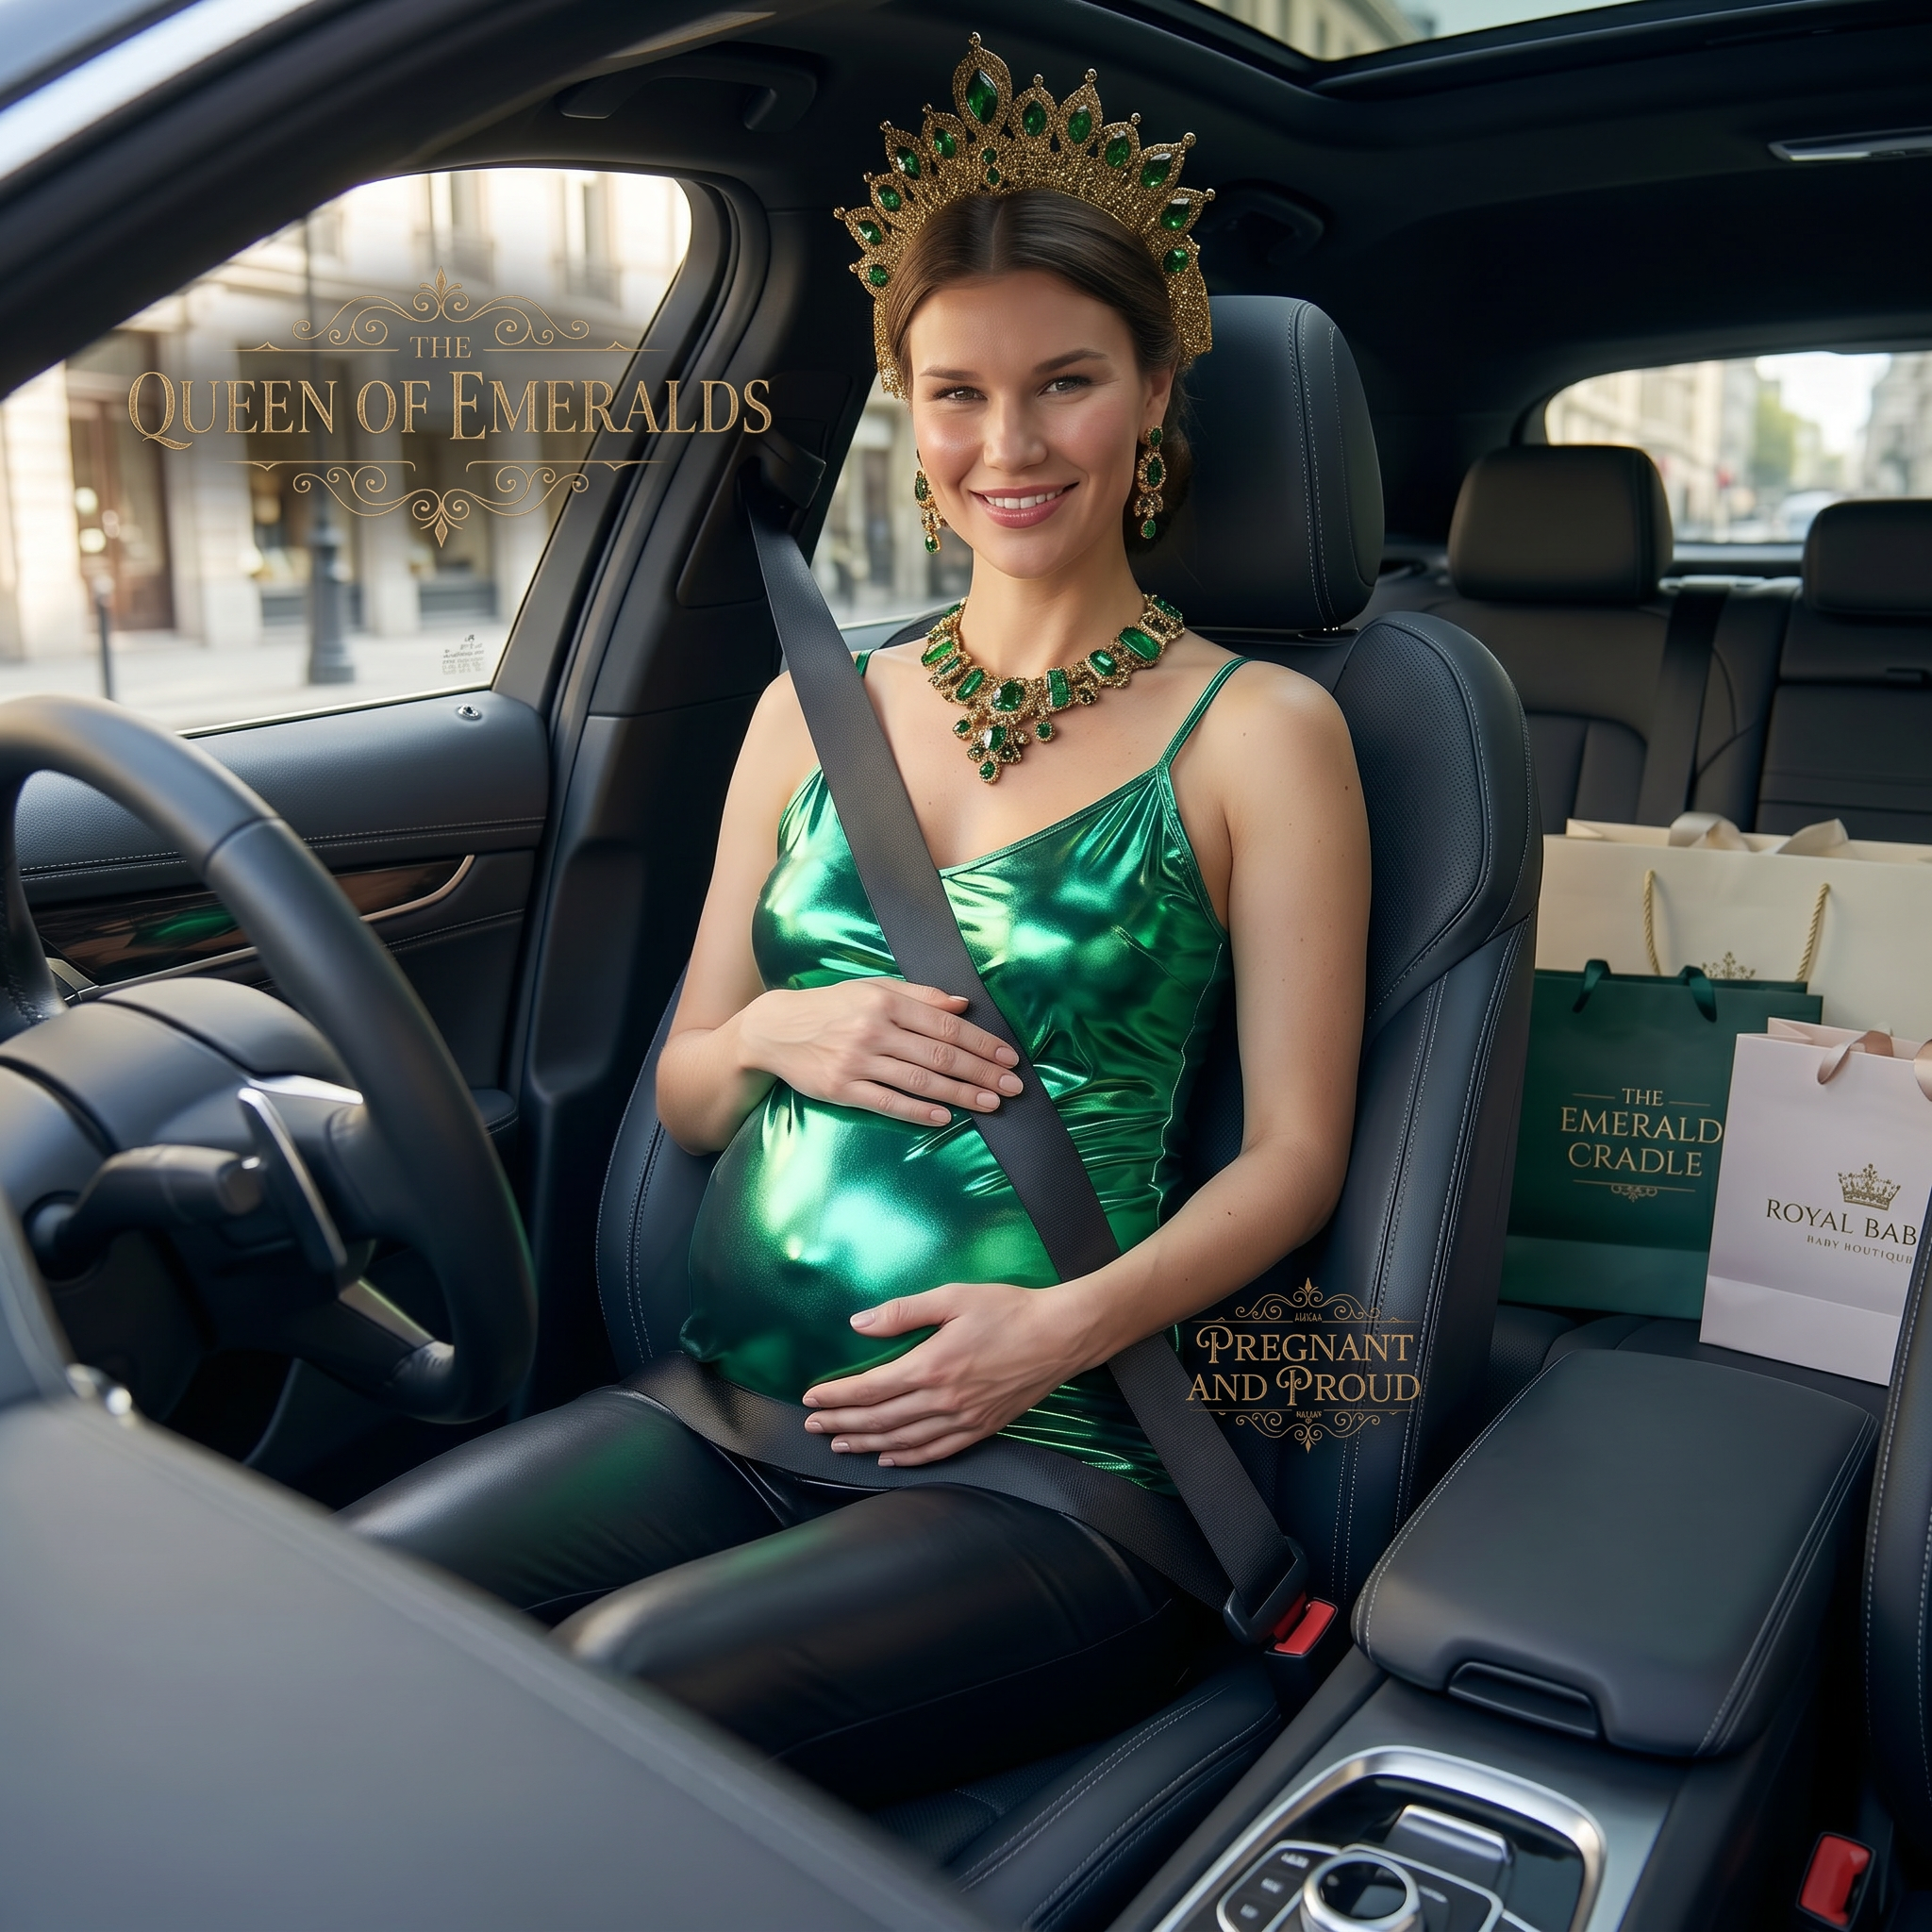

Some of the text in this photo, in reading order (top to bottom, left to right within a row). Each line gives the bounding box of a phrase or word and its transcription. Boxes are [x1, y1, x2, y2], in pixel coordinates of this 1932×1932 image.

[1622, 1088, 1664, 1107] THE
[1560, 1107, 1724, 1144] EMERALD
[1568, 1141, 1703, 1177] CRADLE
[1766, 1198, 1854, 1235] ROYAL
